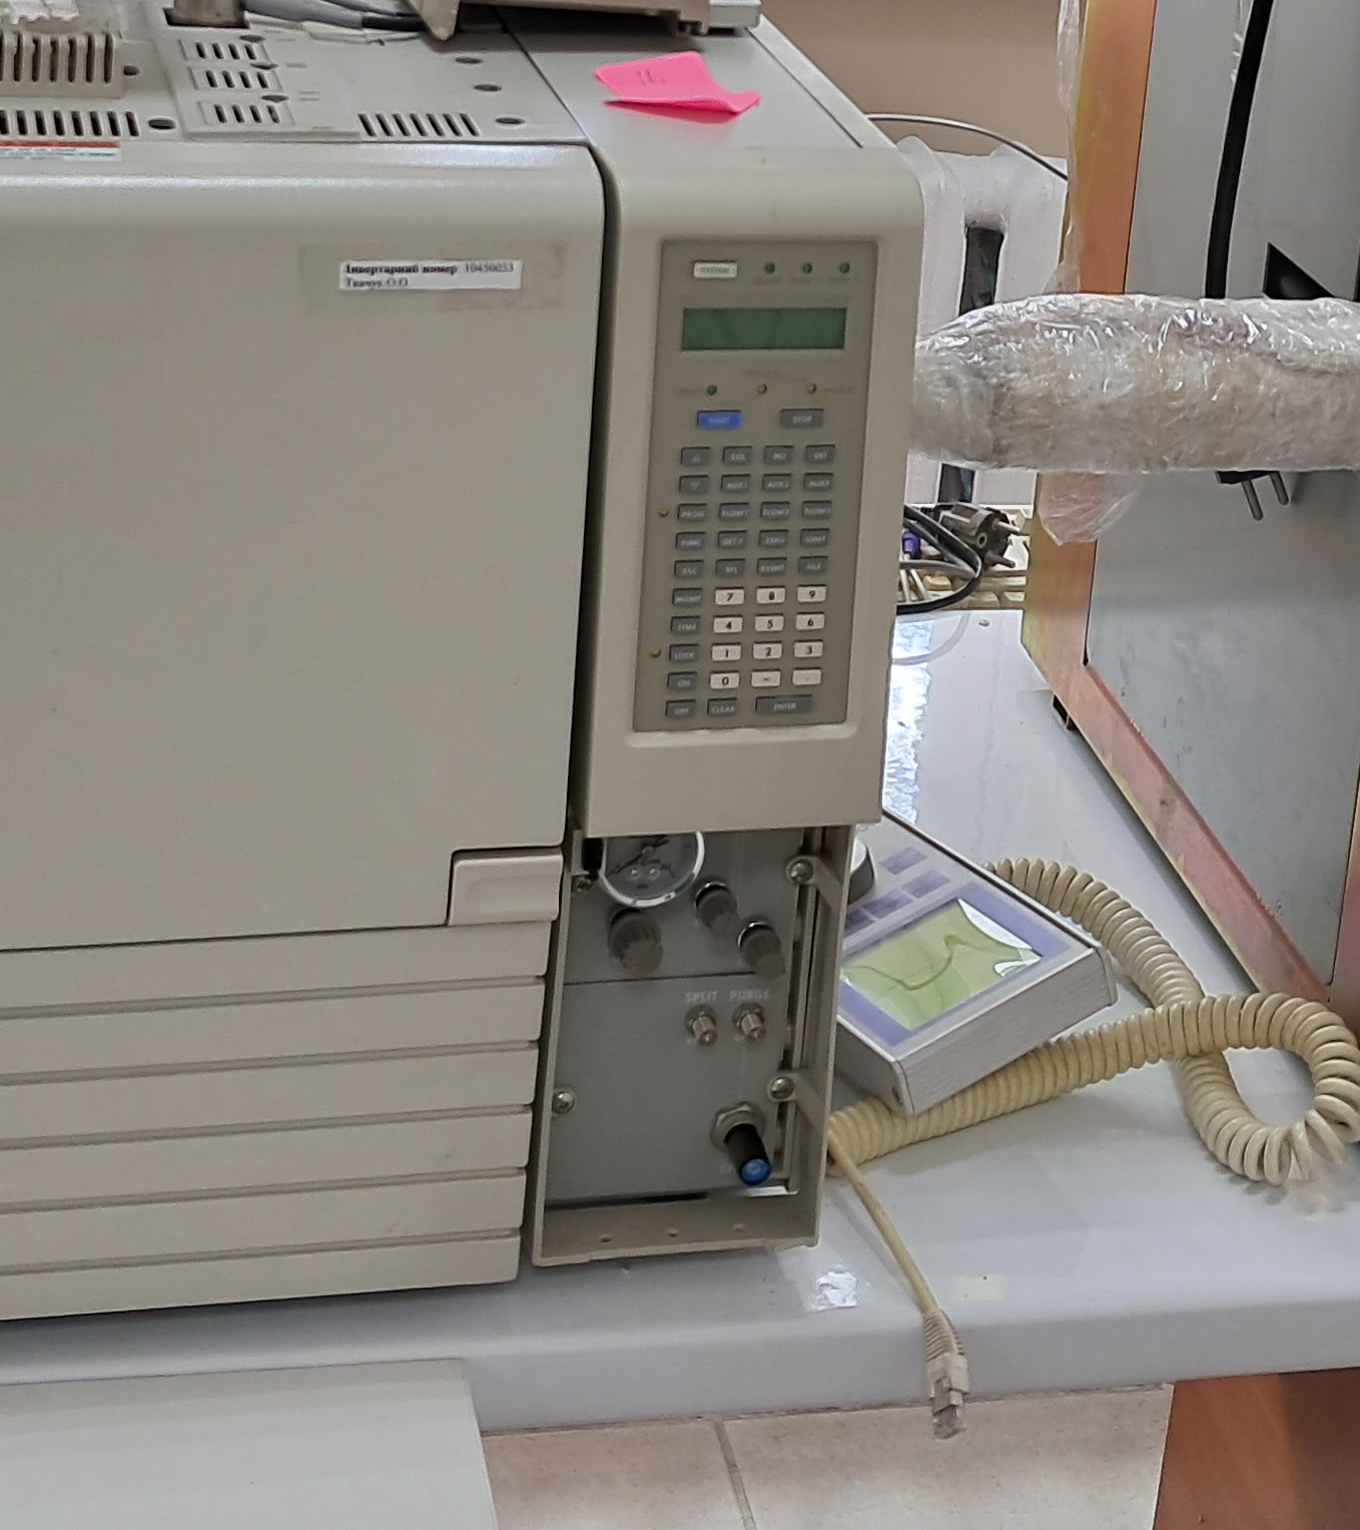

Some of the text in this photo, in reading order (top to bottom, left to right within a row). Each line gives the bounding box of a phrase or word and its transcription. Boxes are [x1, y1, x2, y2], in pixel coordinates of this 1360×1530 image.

[726, 592, 734, 602] 7
[768, 591, 775, 601] 8
[808, 590, 816, 599] 9
[725, 620, 733, 630] 4
[767, 618, 774, 629] 5
[807, 617, 815, 627] 6
[766, 646, 773, 657] 2
[806, 645, 814, 655] 3
[721, 676, 729, 686] 0
[685, 991, 718, 1003] SPLIT
